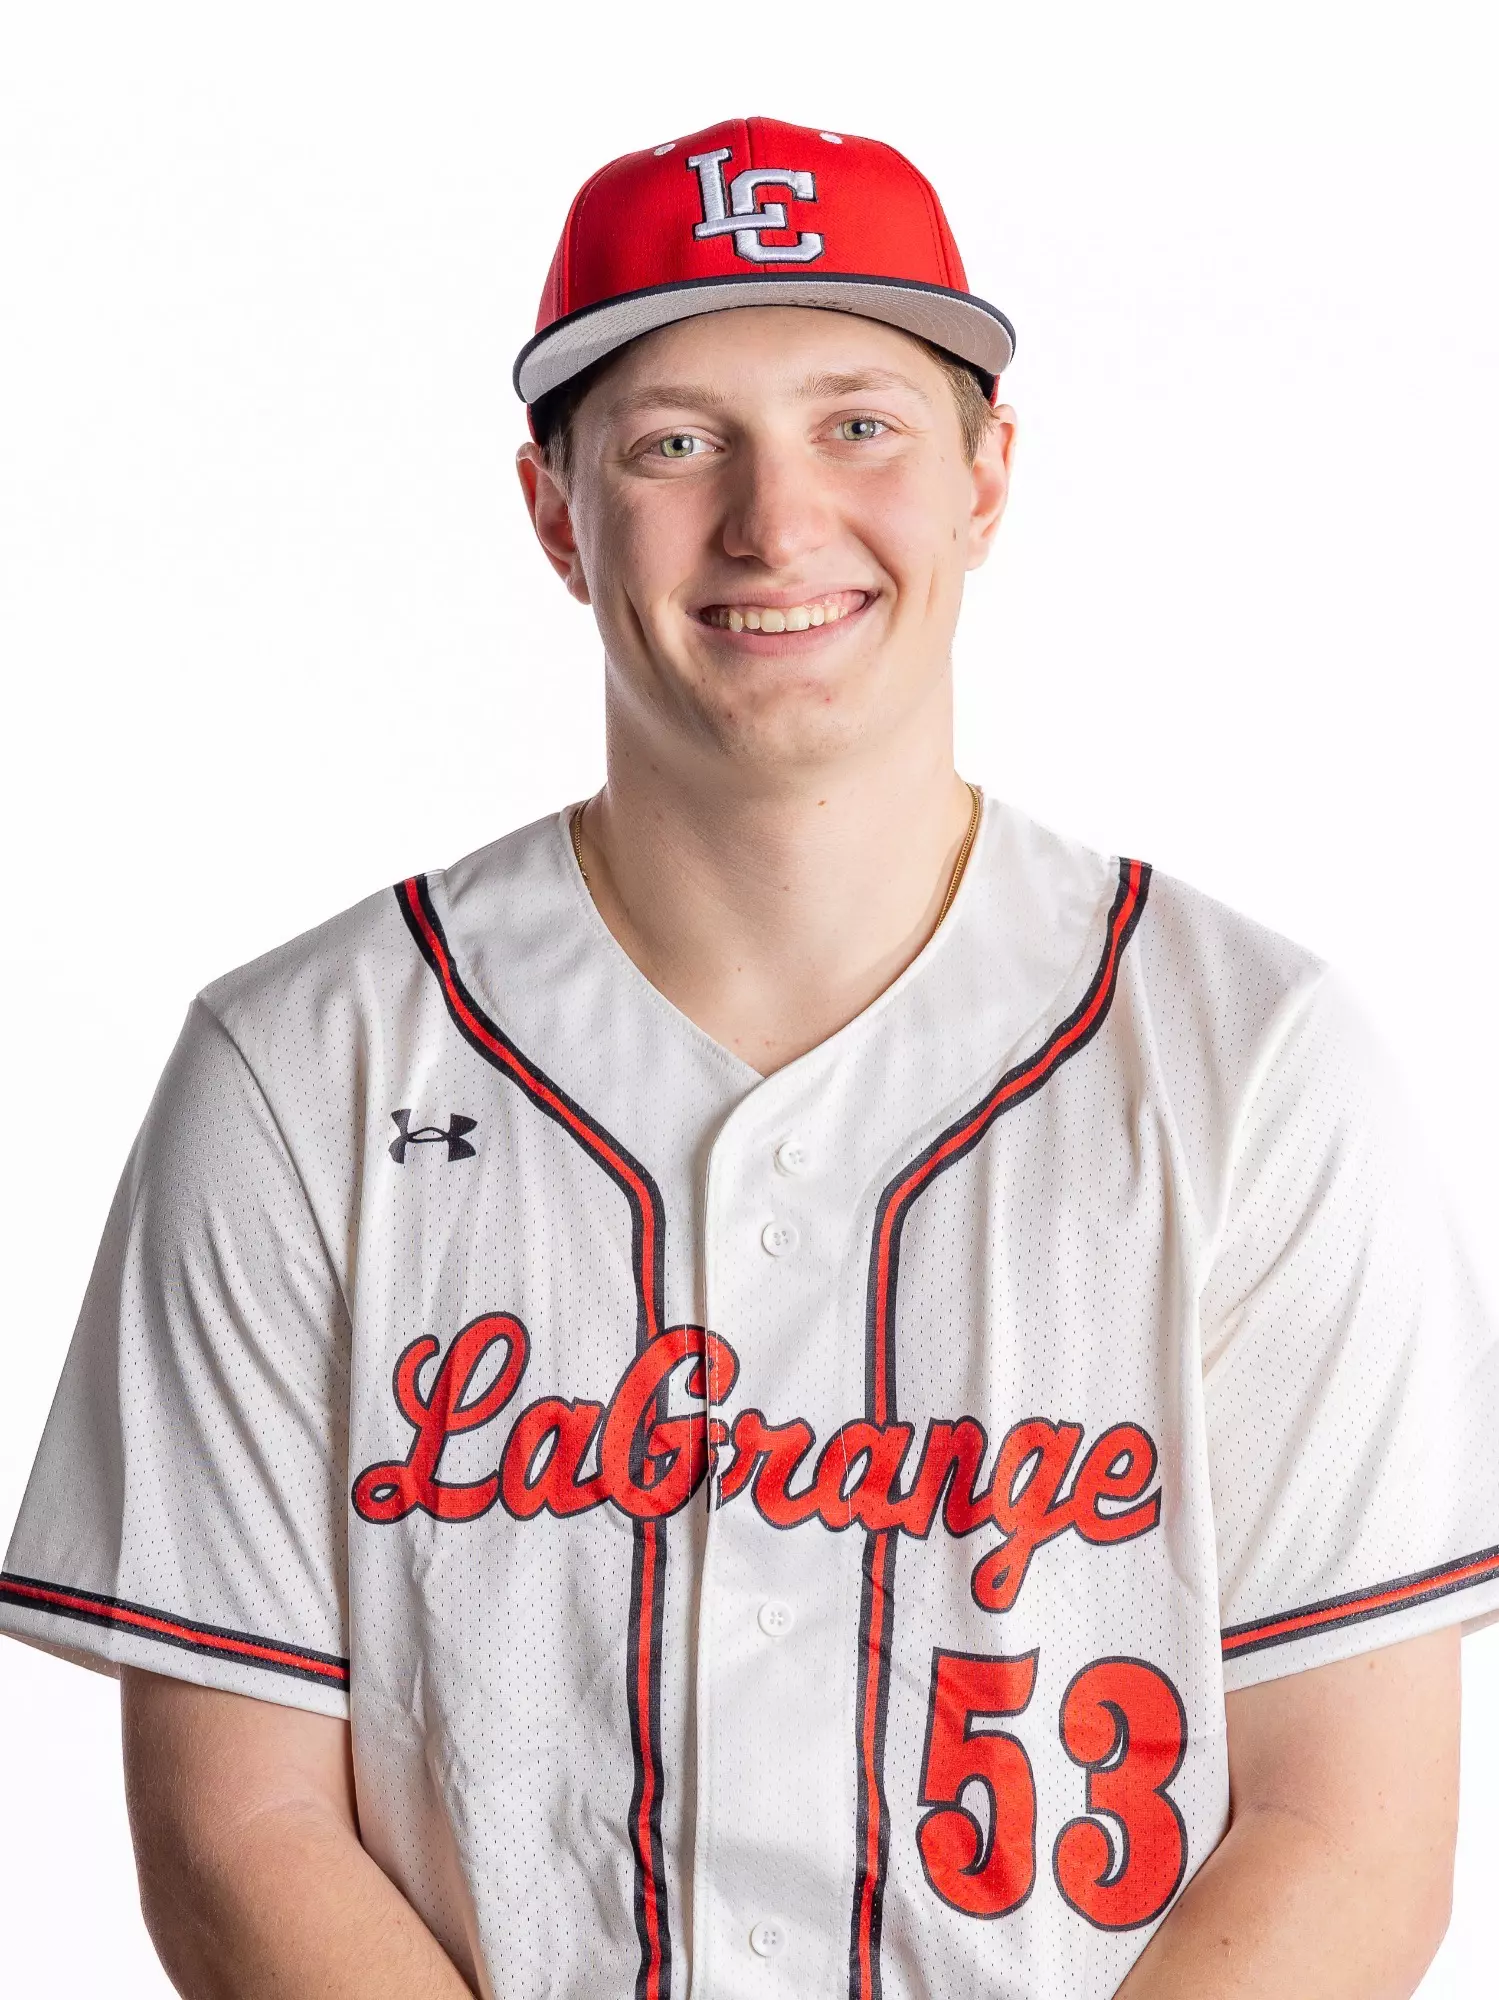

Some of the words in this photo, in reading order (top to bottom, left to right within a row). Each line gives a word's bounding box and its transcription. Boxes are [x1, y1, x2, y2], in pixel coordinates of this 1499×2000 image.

[686, 147, 825, 264] LC
[352, 1312, 1163, 1613] LaGrange
[916, 1646, 1188, 1933] 53
